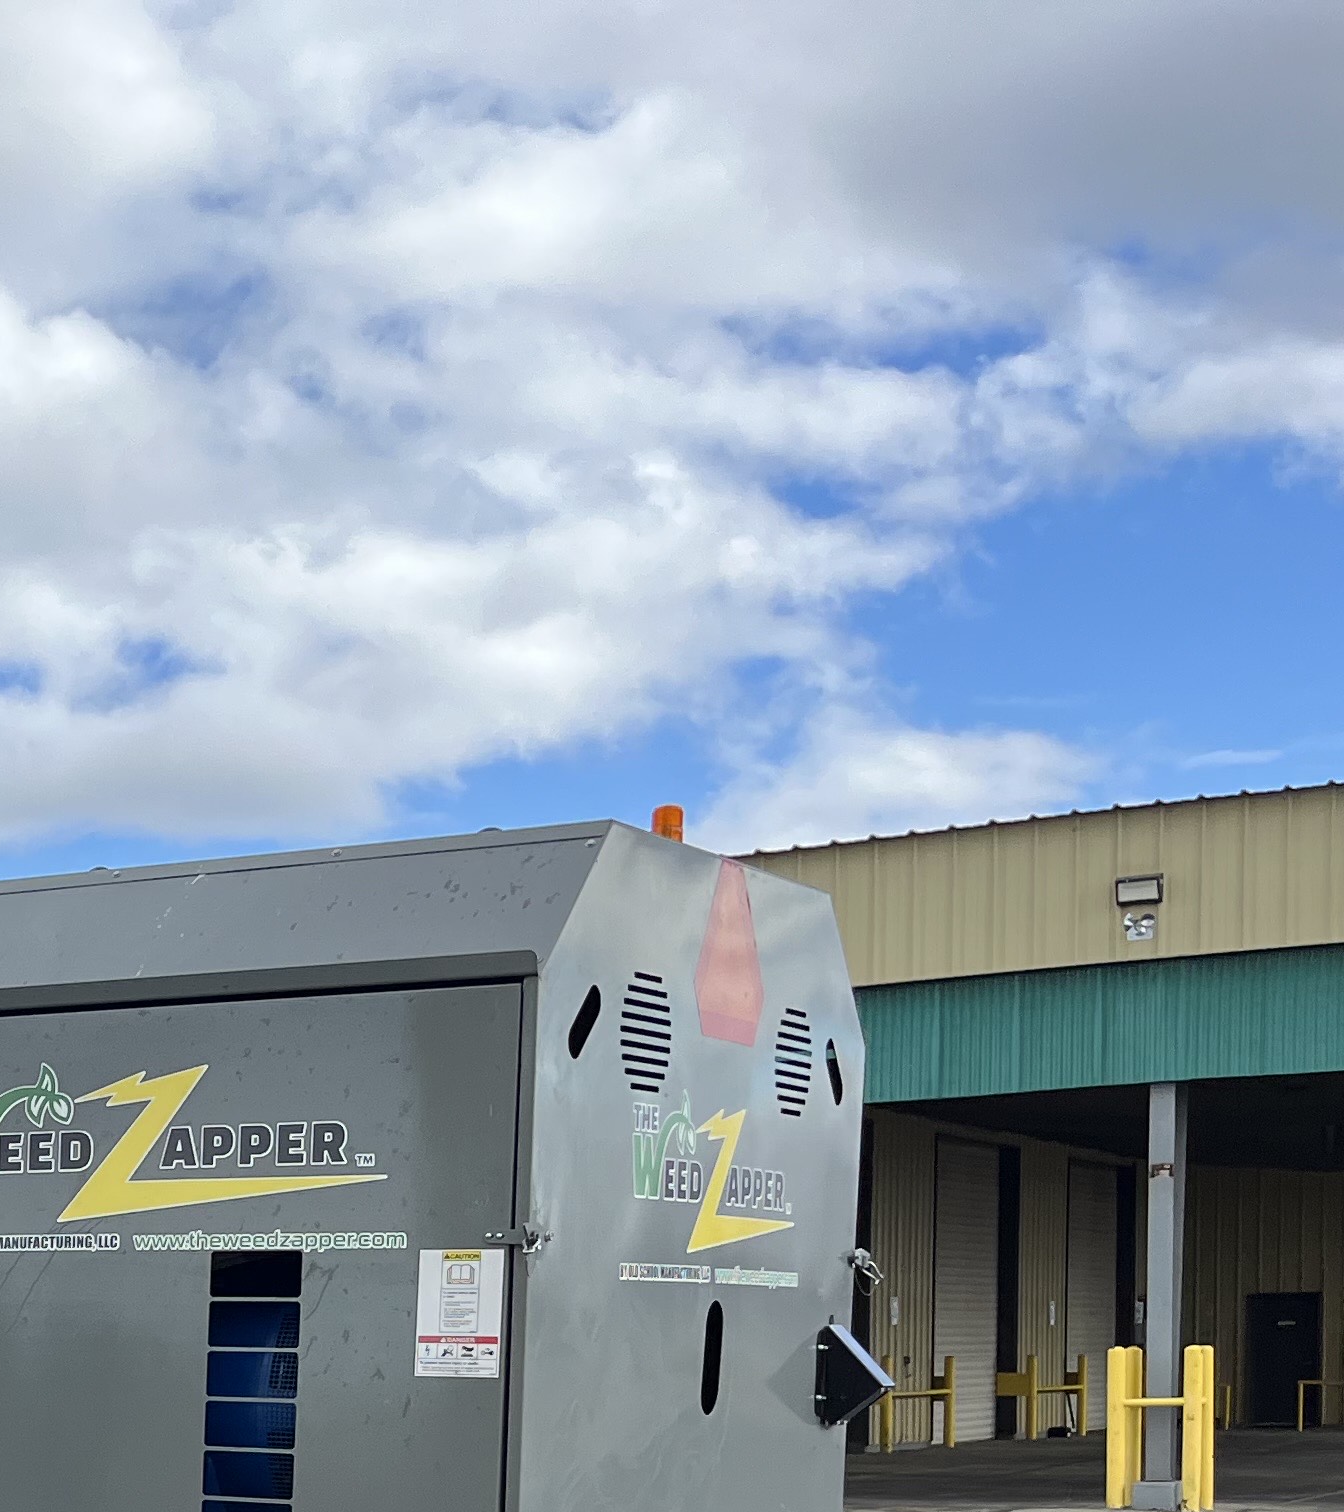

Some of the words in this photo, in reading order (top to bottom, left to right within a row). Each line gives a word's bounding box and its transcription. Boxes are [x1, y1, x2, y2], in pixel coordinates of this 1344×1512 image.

[633, 1102, 660, 1133] THE
[97, 1233, 120, 1251] LLC
[133, 1229, 408, 1253] www.theweedzapper.com
